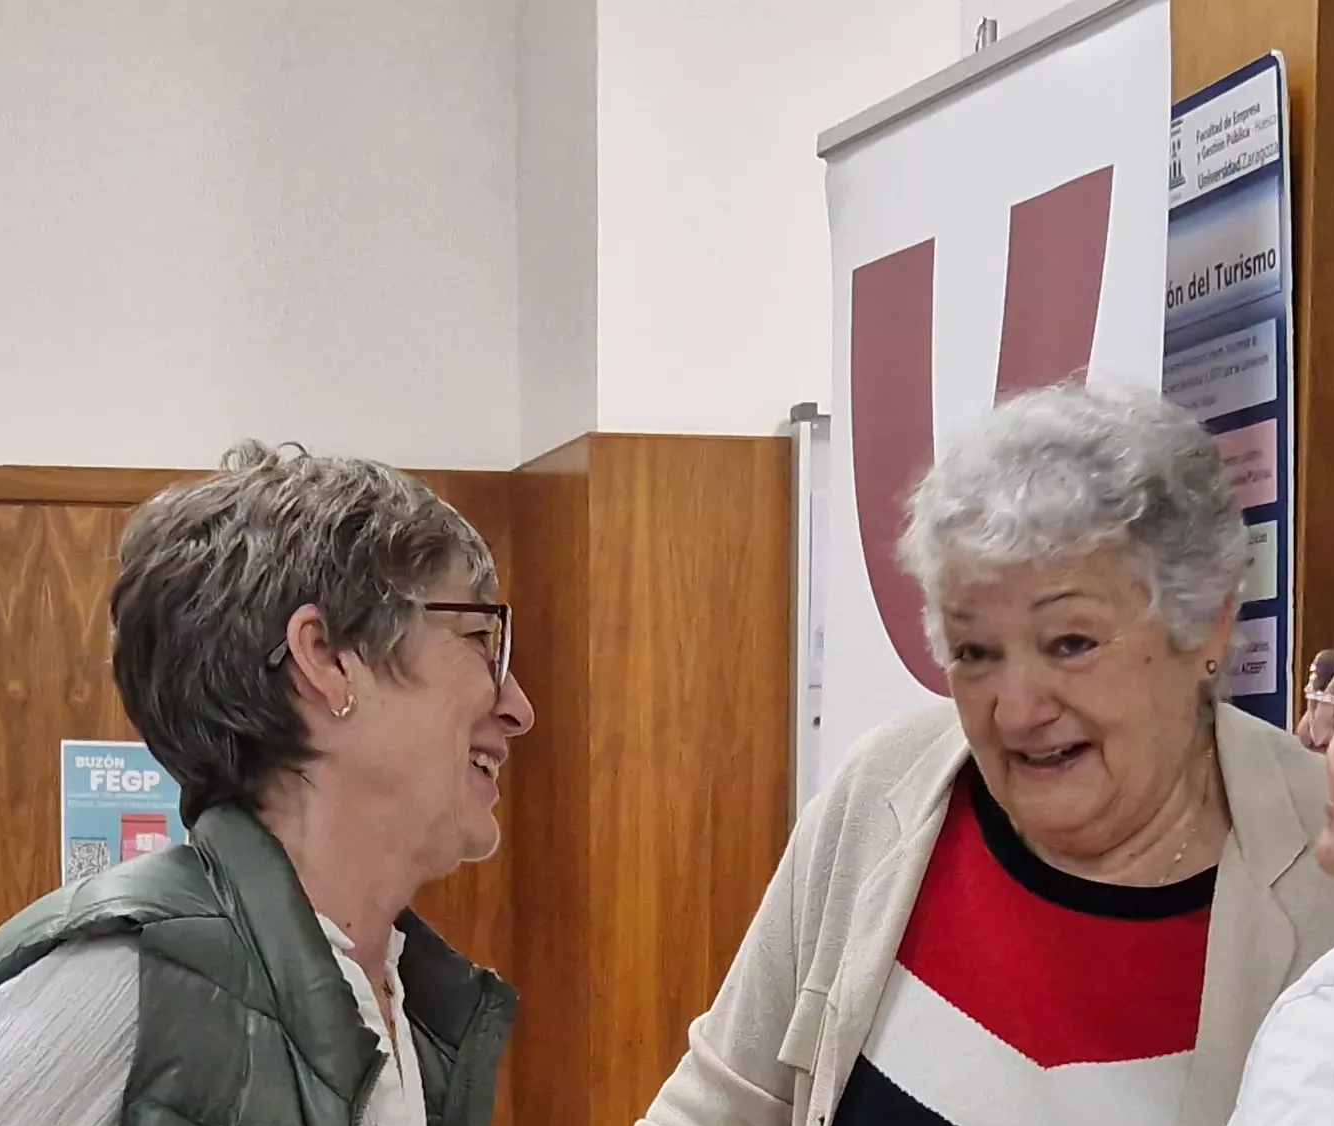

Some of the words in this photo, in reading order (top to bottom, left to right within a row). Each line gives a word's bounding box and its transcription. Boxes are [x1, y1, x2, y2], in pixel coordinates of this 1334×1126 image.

[1187, 266, 1210, 301] del
[1214, 247, 1276, 291] Turismo
[74, 752, 126, 769] BUZÓN
[89, 769, 161, 793] FEGP
